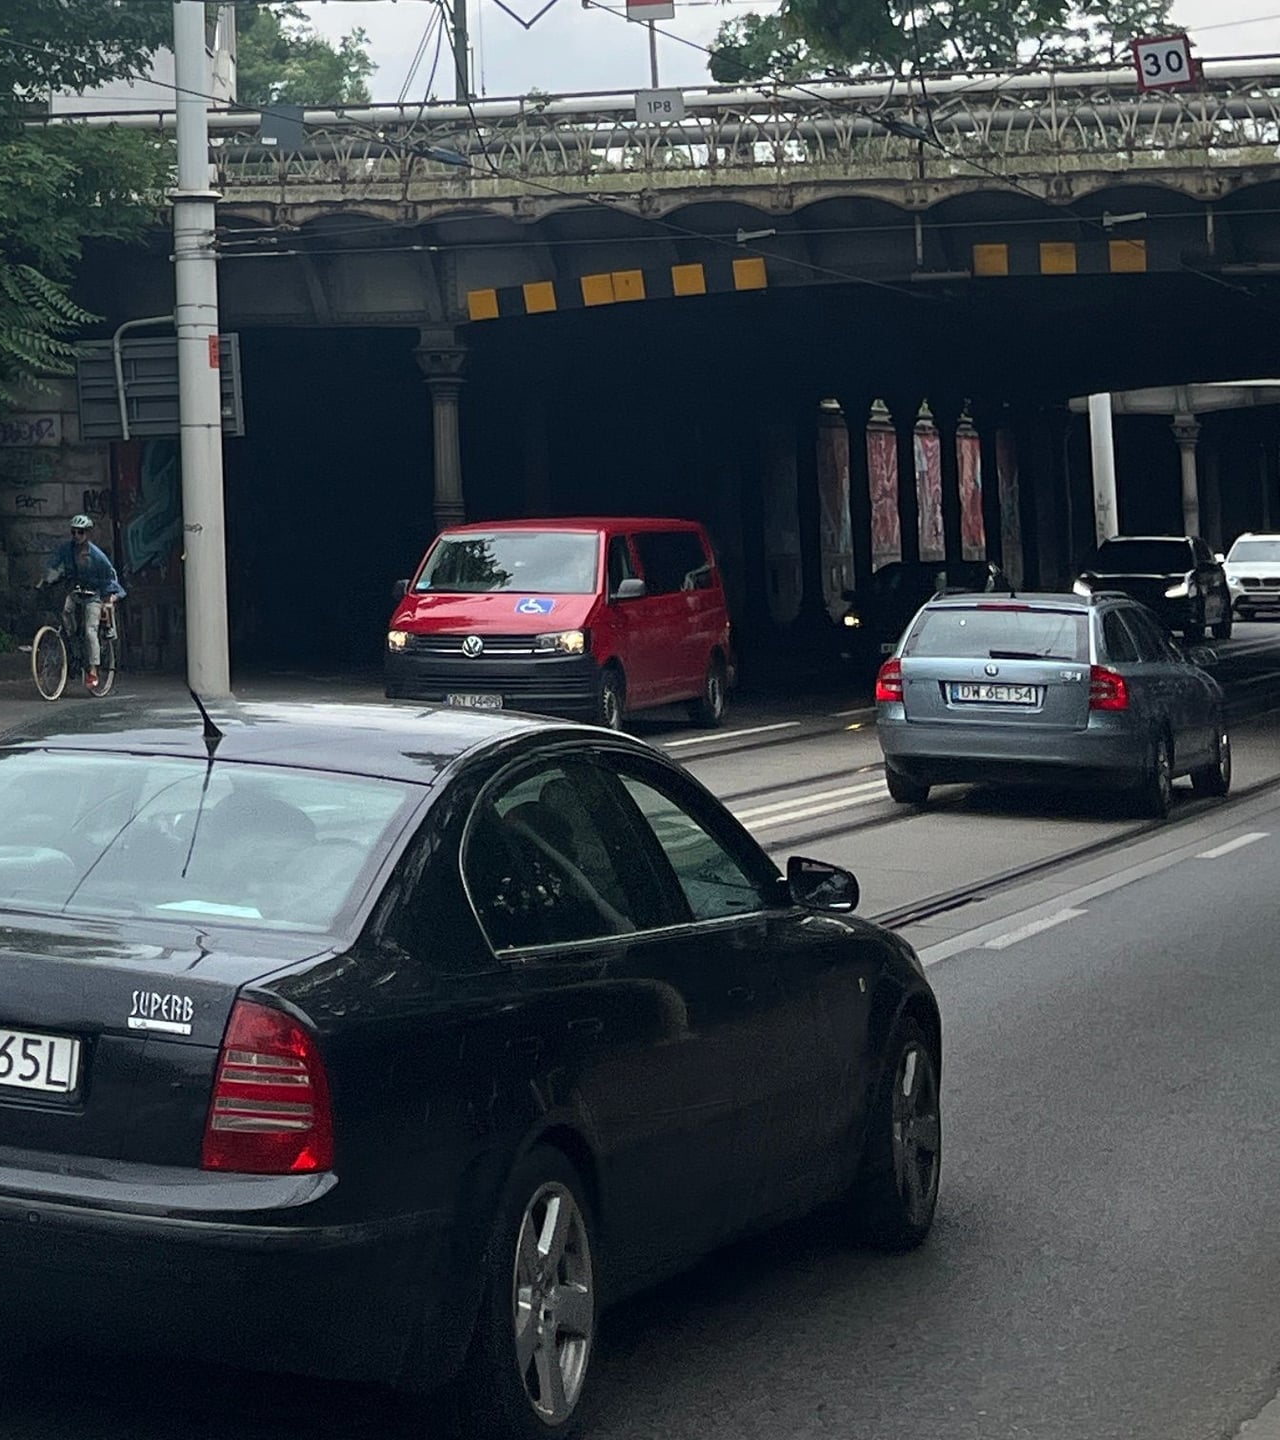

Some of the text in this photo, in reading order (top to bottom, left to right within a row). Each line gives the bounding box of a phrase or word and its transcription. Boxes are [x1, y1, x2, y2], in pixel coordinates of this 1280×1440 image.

[1143, 49, 1184, 77] 30
[647, 100, 672, 114] 1P8
[130, 990, 194, 1022] SUPERB
